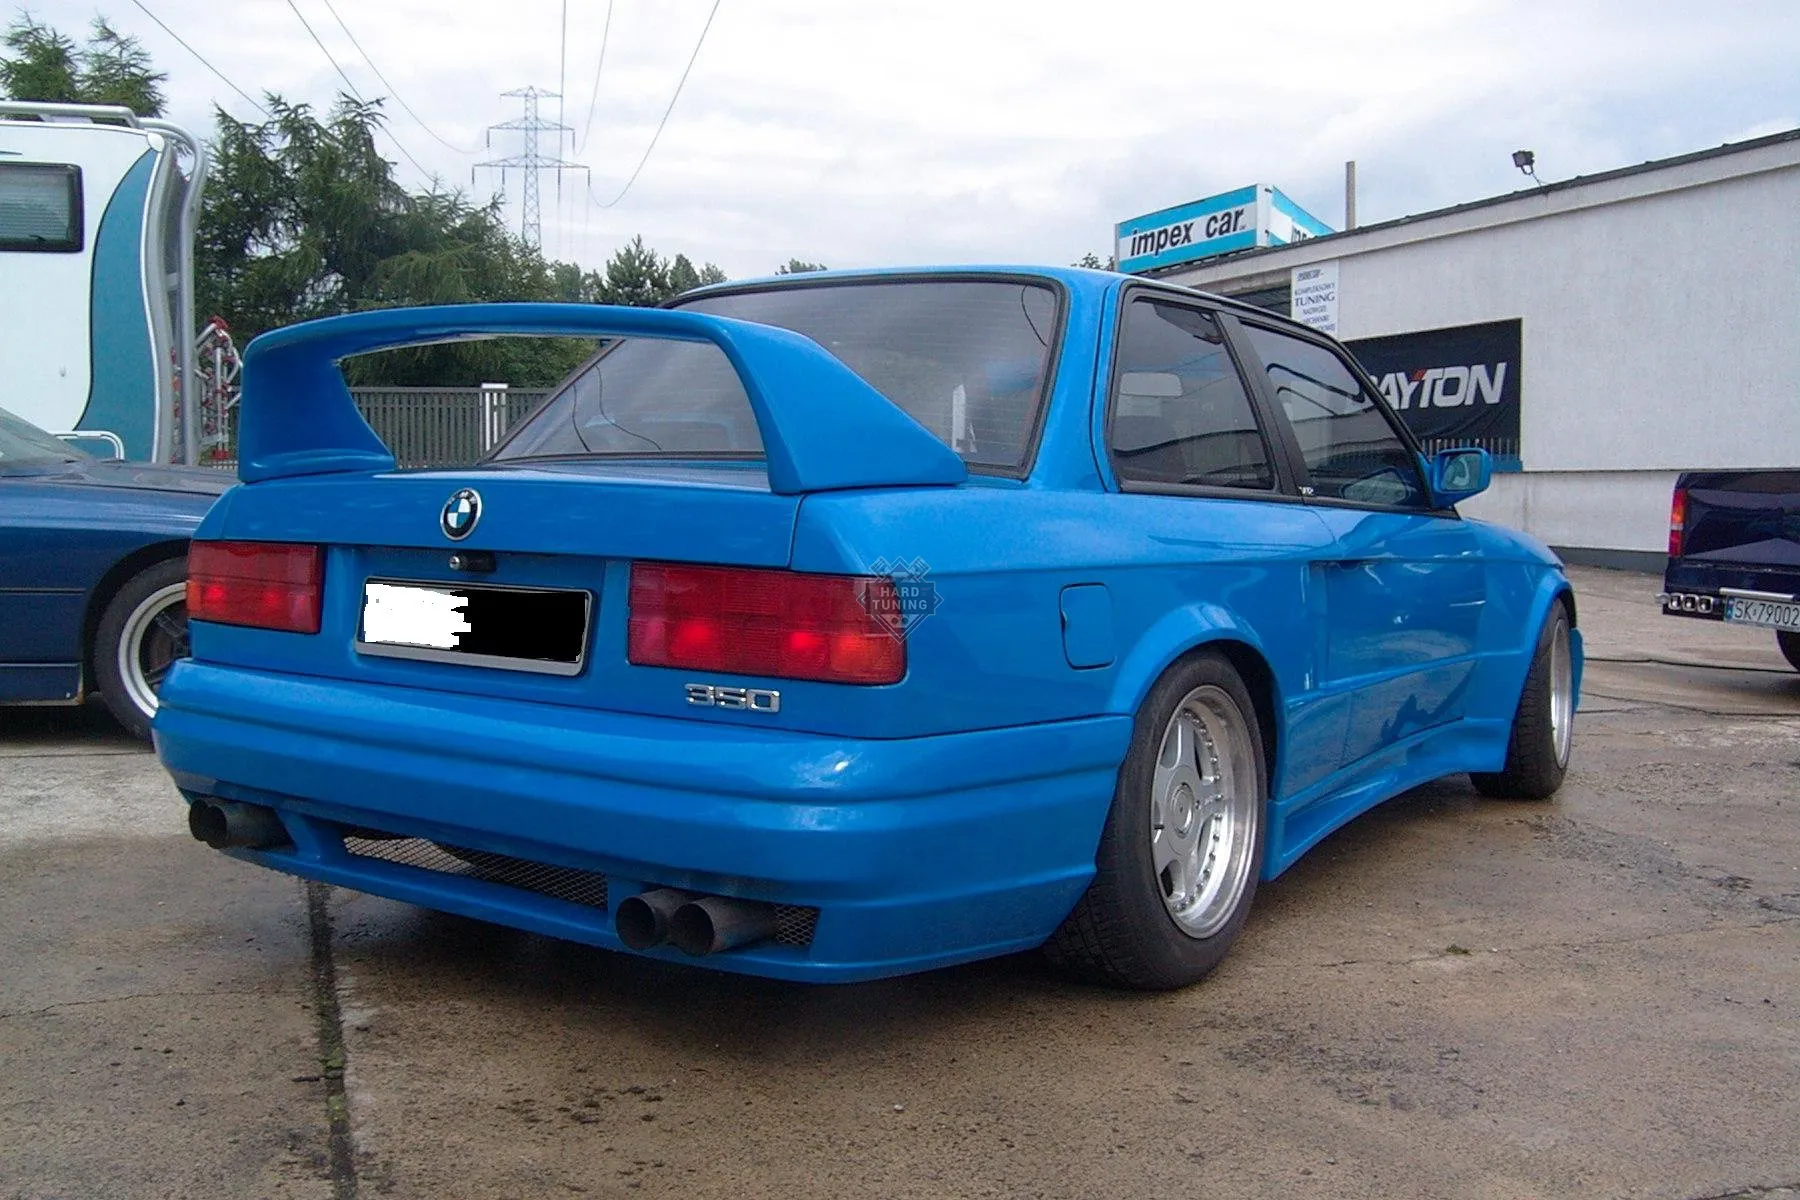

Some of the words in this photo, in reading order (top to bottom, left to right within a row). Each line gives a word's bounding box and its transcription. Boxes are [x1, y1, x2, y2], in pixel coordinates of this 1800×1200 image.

[1130, 221, 1195, 257] impex
[1205, 207, 1245, 238] car
[1294, 291, 1335, 307] TUNING
[1370, 362, 1507, 410] AYTON
[1734, 600, 1753, 621] SK
[1757, 603, 1800, 627] 79002
[684, 683, 780, 713] 350
